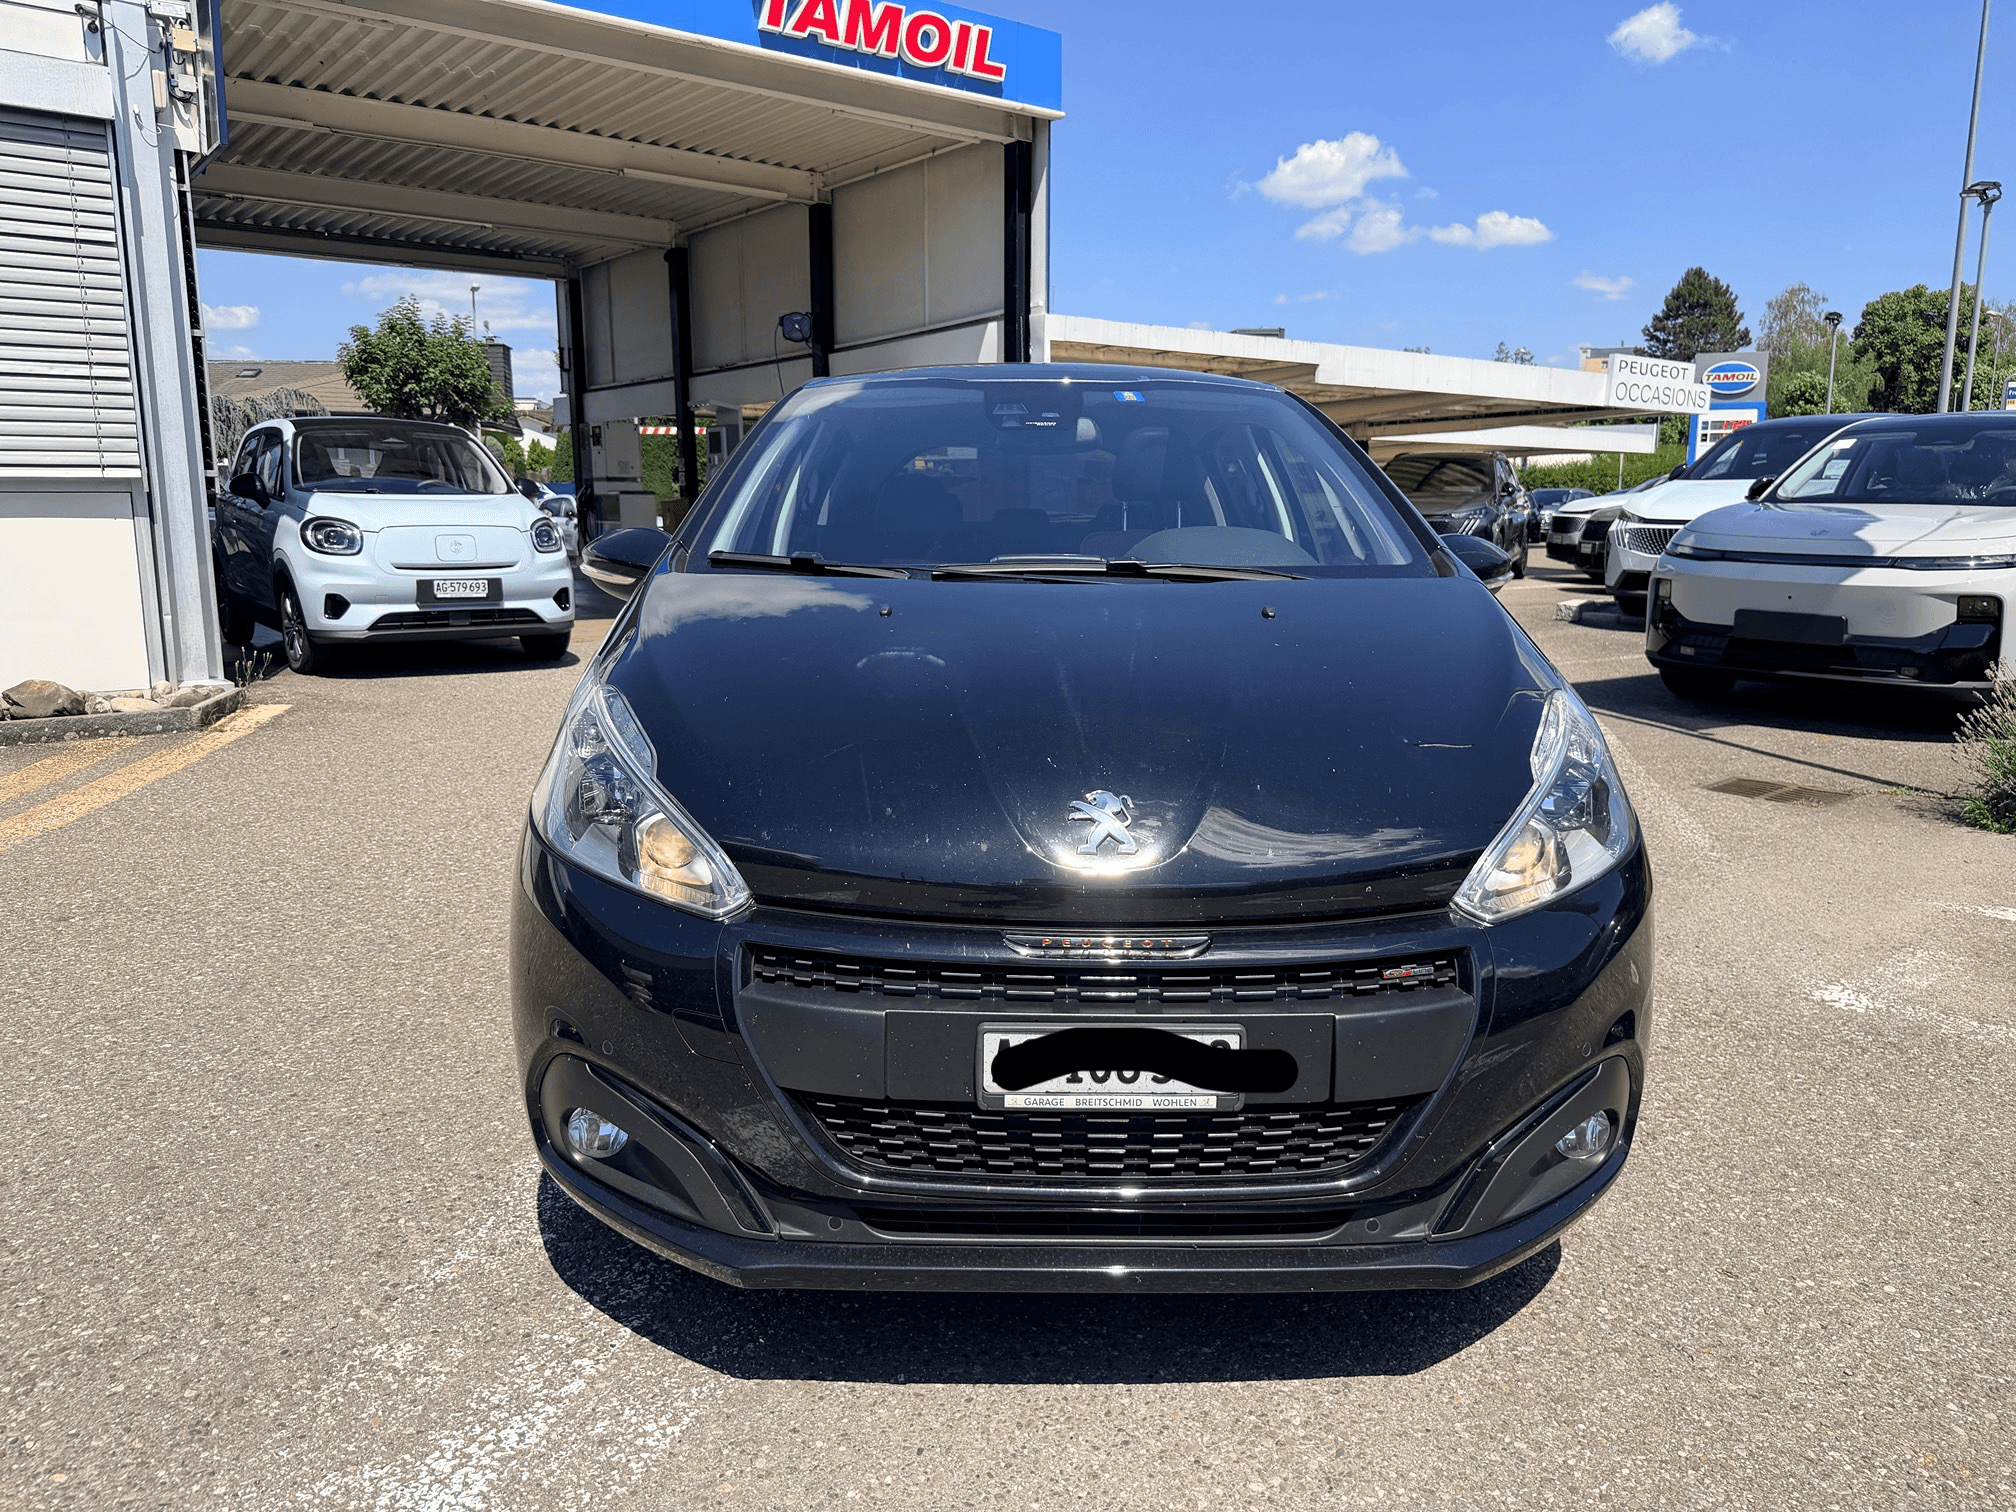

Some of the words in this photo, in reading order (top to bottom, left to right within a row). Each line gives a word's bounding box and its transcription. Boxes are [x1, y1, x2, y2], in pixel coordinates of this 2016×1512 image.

[1618, 359, 1689, 380] PEUGEOT
[1705, 372, 1758, 383] TAMOIL
[1615, 381, 1707, 409] OCCASIONS
[1042, 938, 1173, 948] PEUGEOT
[1024, 1097, 1065, 1107] GARAGE
[1075, 1097, 1143, 1107] BREITSCHMID
[1152, 1097, 1197, 1107] WOHLEN
